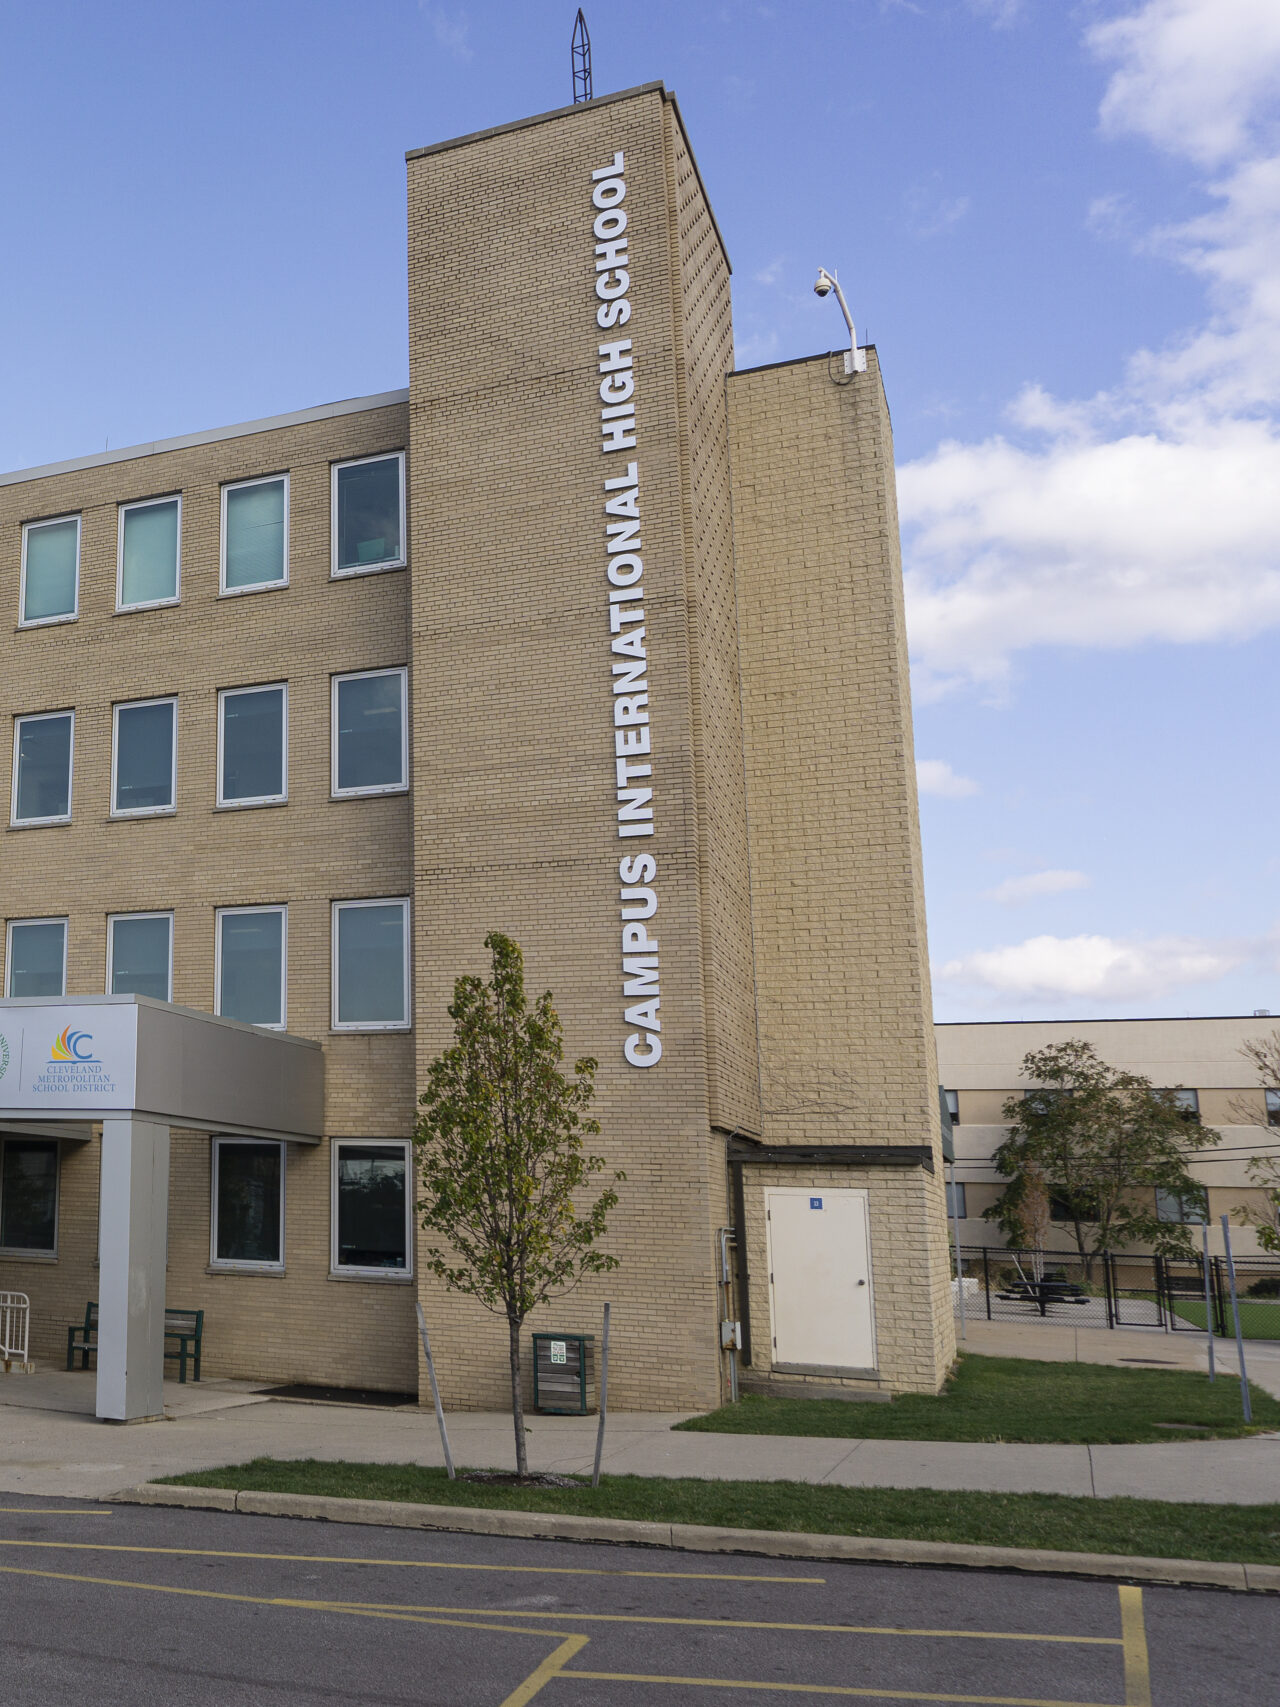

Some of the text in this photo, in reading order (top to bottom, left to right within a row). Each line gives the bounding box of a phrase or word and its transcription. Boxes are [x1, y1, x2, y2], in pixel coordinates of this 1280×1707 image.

[591, 151, 662, 1068] CAMPUS INTERNATIONAL HIGH SCHOOL
[46, 1065, 102, 1074] CLEVELAND
[38, 1074, 111, 1083] METROPOLITAN
[32, 1083, 116, 1093] SCHOOL DISTRICT
